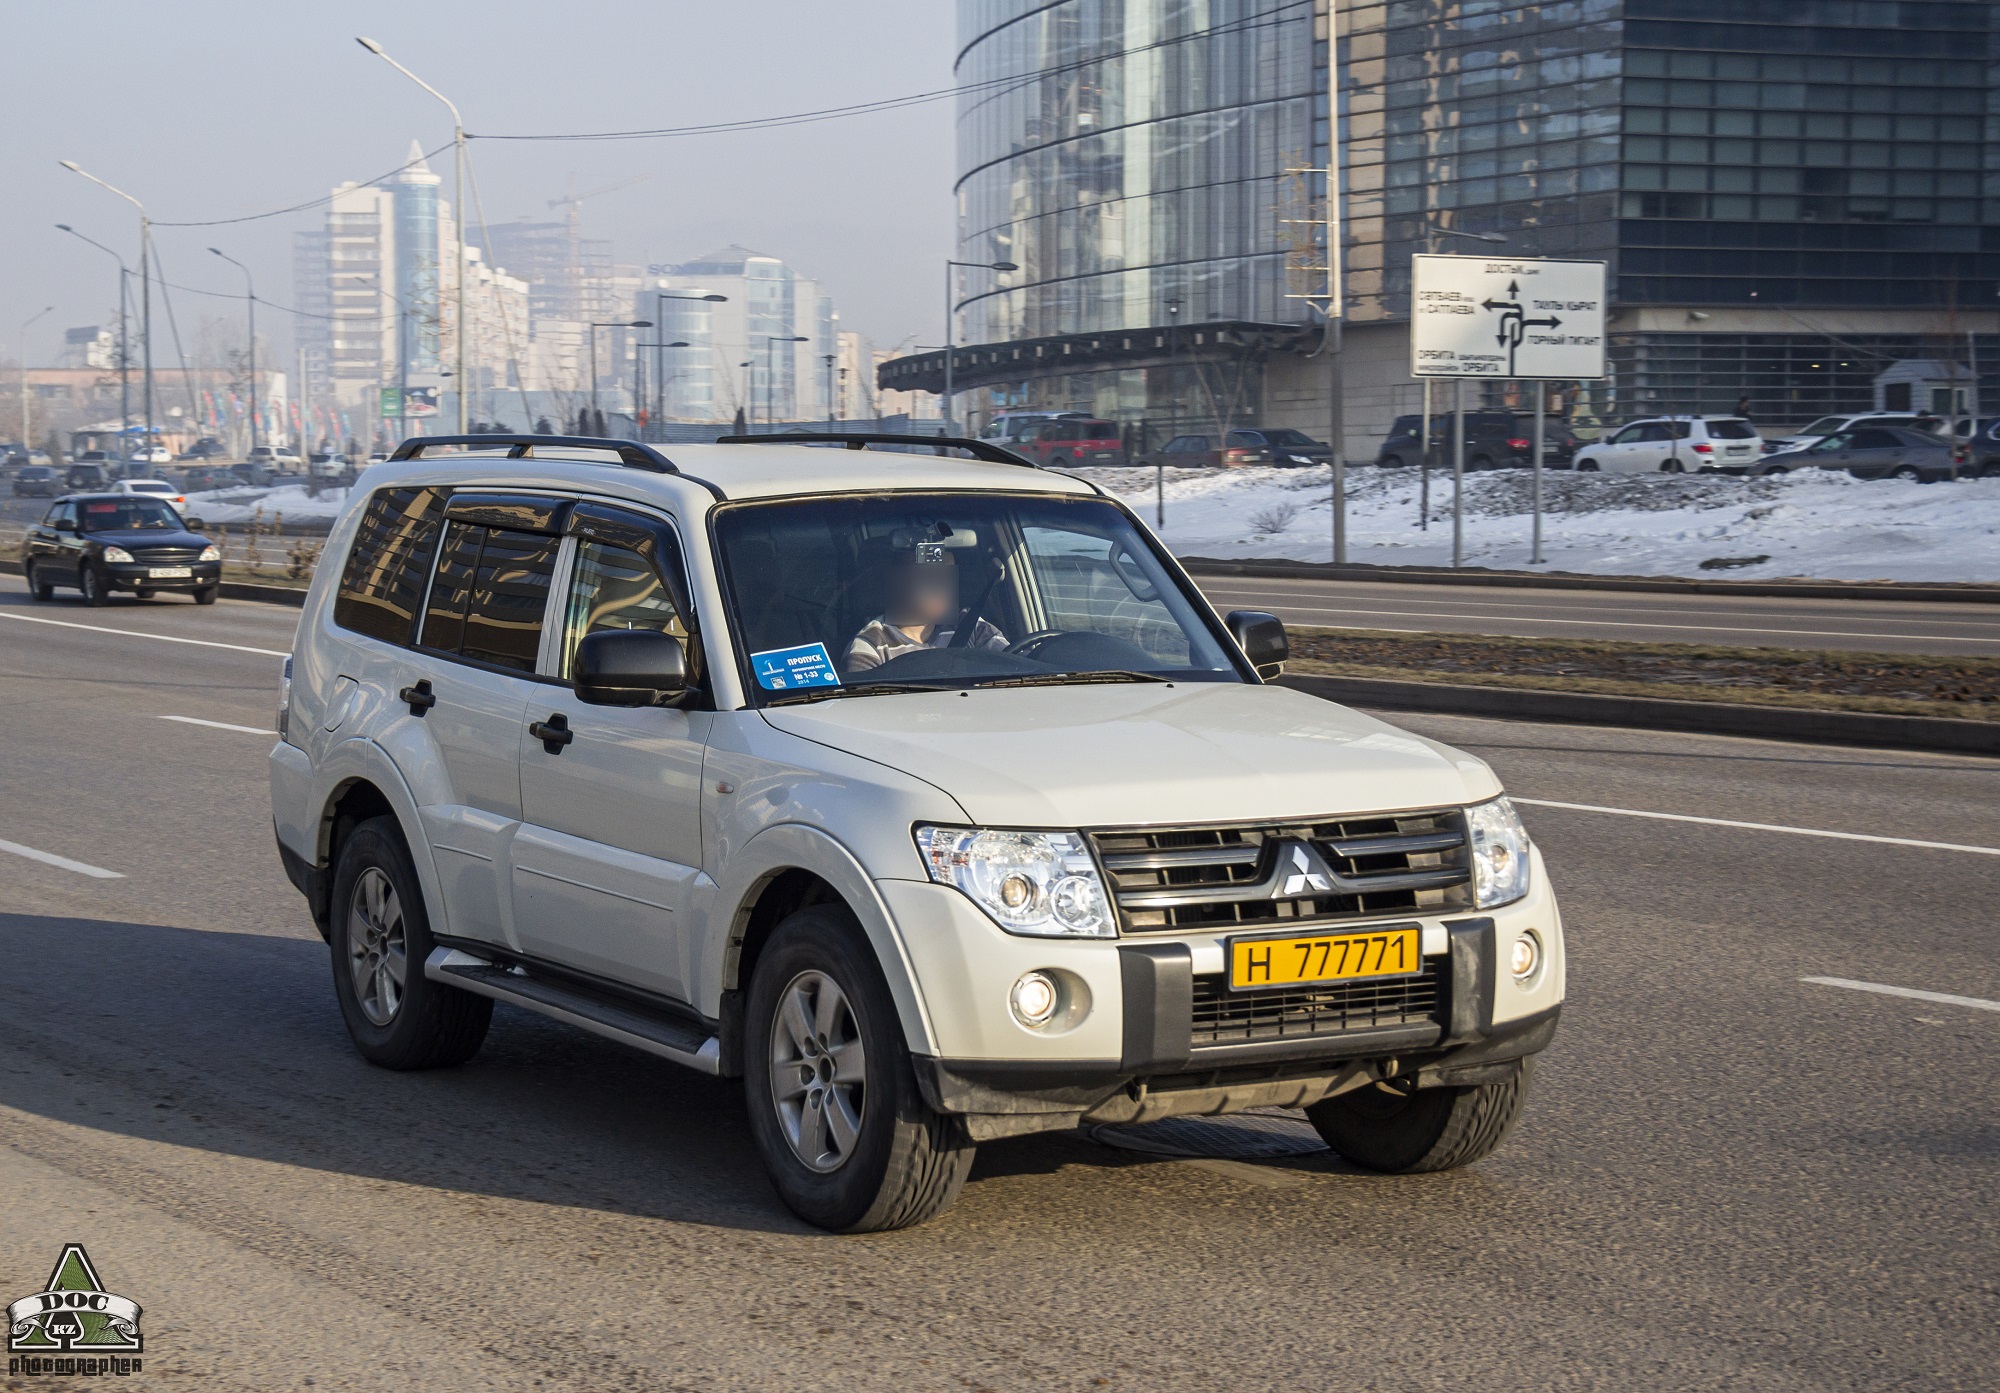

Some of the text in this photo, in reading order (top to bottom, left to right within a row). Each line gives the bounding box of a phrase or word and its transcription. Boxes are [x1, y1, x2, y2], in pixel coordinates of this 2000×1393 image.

[1428, 304, 1474, 314] САТПАЕВА
[1527, 334, 1601, 346] ГОРНЫЙ ГИГАНТ
[1418, 350, 1455, 359] ОРБИТА
[1462, 363, 1499, 372] ОРБИТА
[787, 654, 822, 666] ПРОПУСК
[804, 671, 819, 679] 1-33
[1294, 934, 1405, 978] 777771
